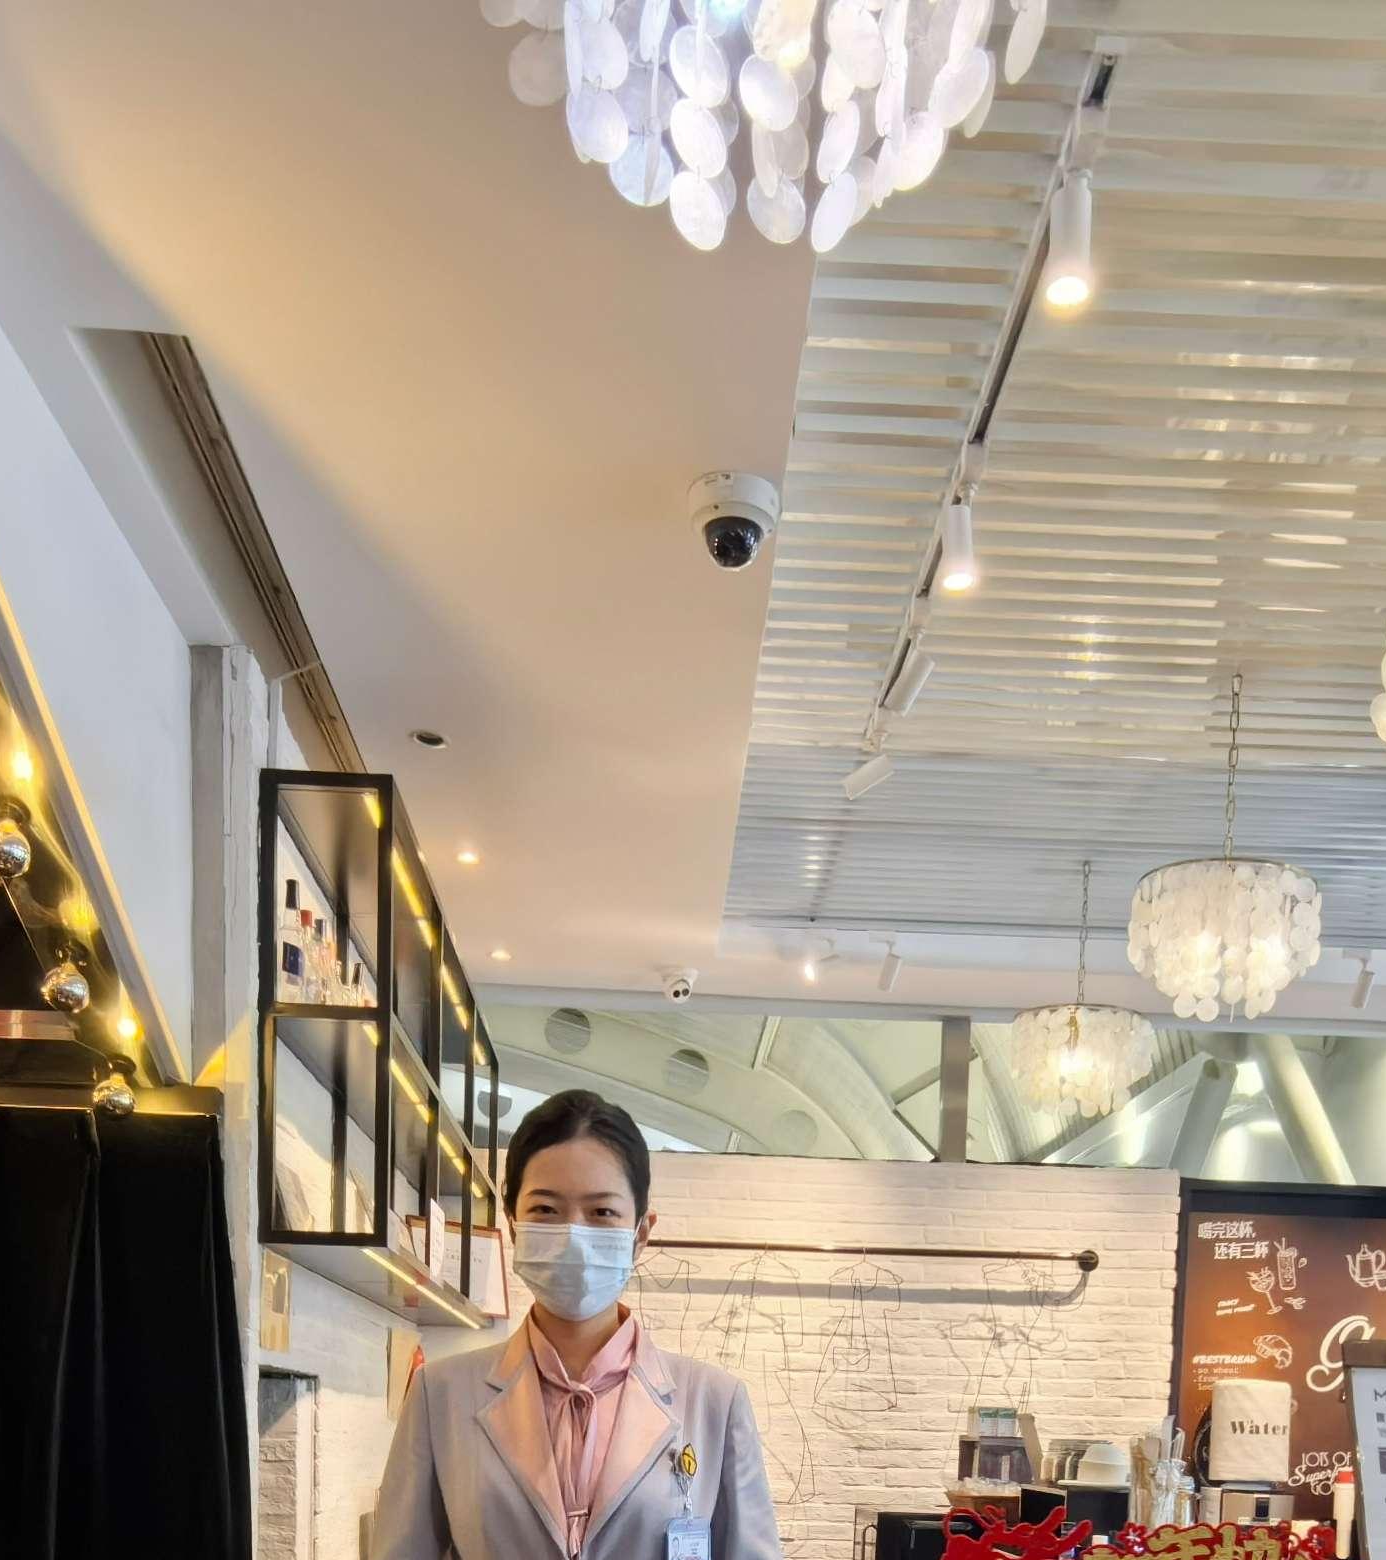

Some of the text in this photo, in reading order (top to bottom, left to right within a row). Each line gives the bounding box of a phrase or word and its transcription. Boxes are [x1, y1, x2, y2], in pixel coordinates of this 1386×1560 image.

[1213, 1241, 1270, 1260] 还有三杯
[1230, 1420, 1289, 1436] Water
